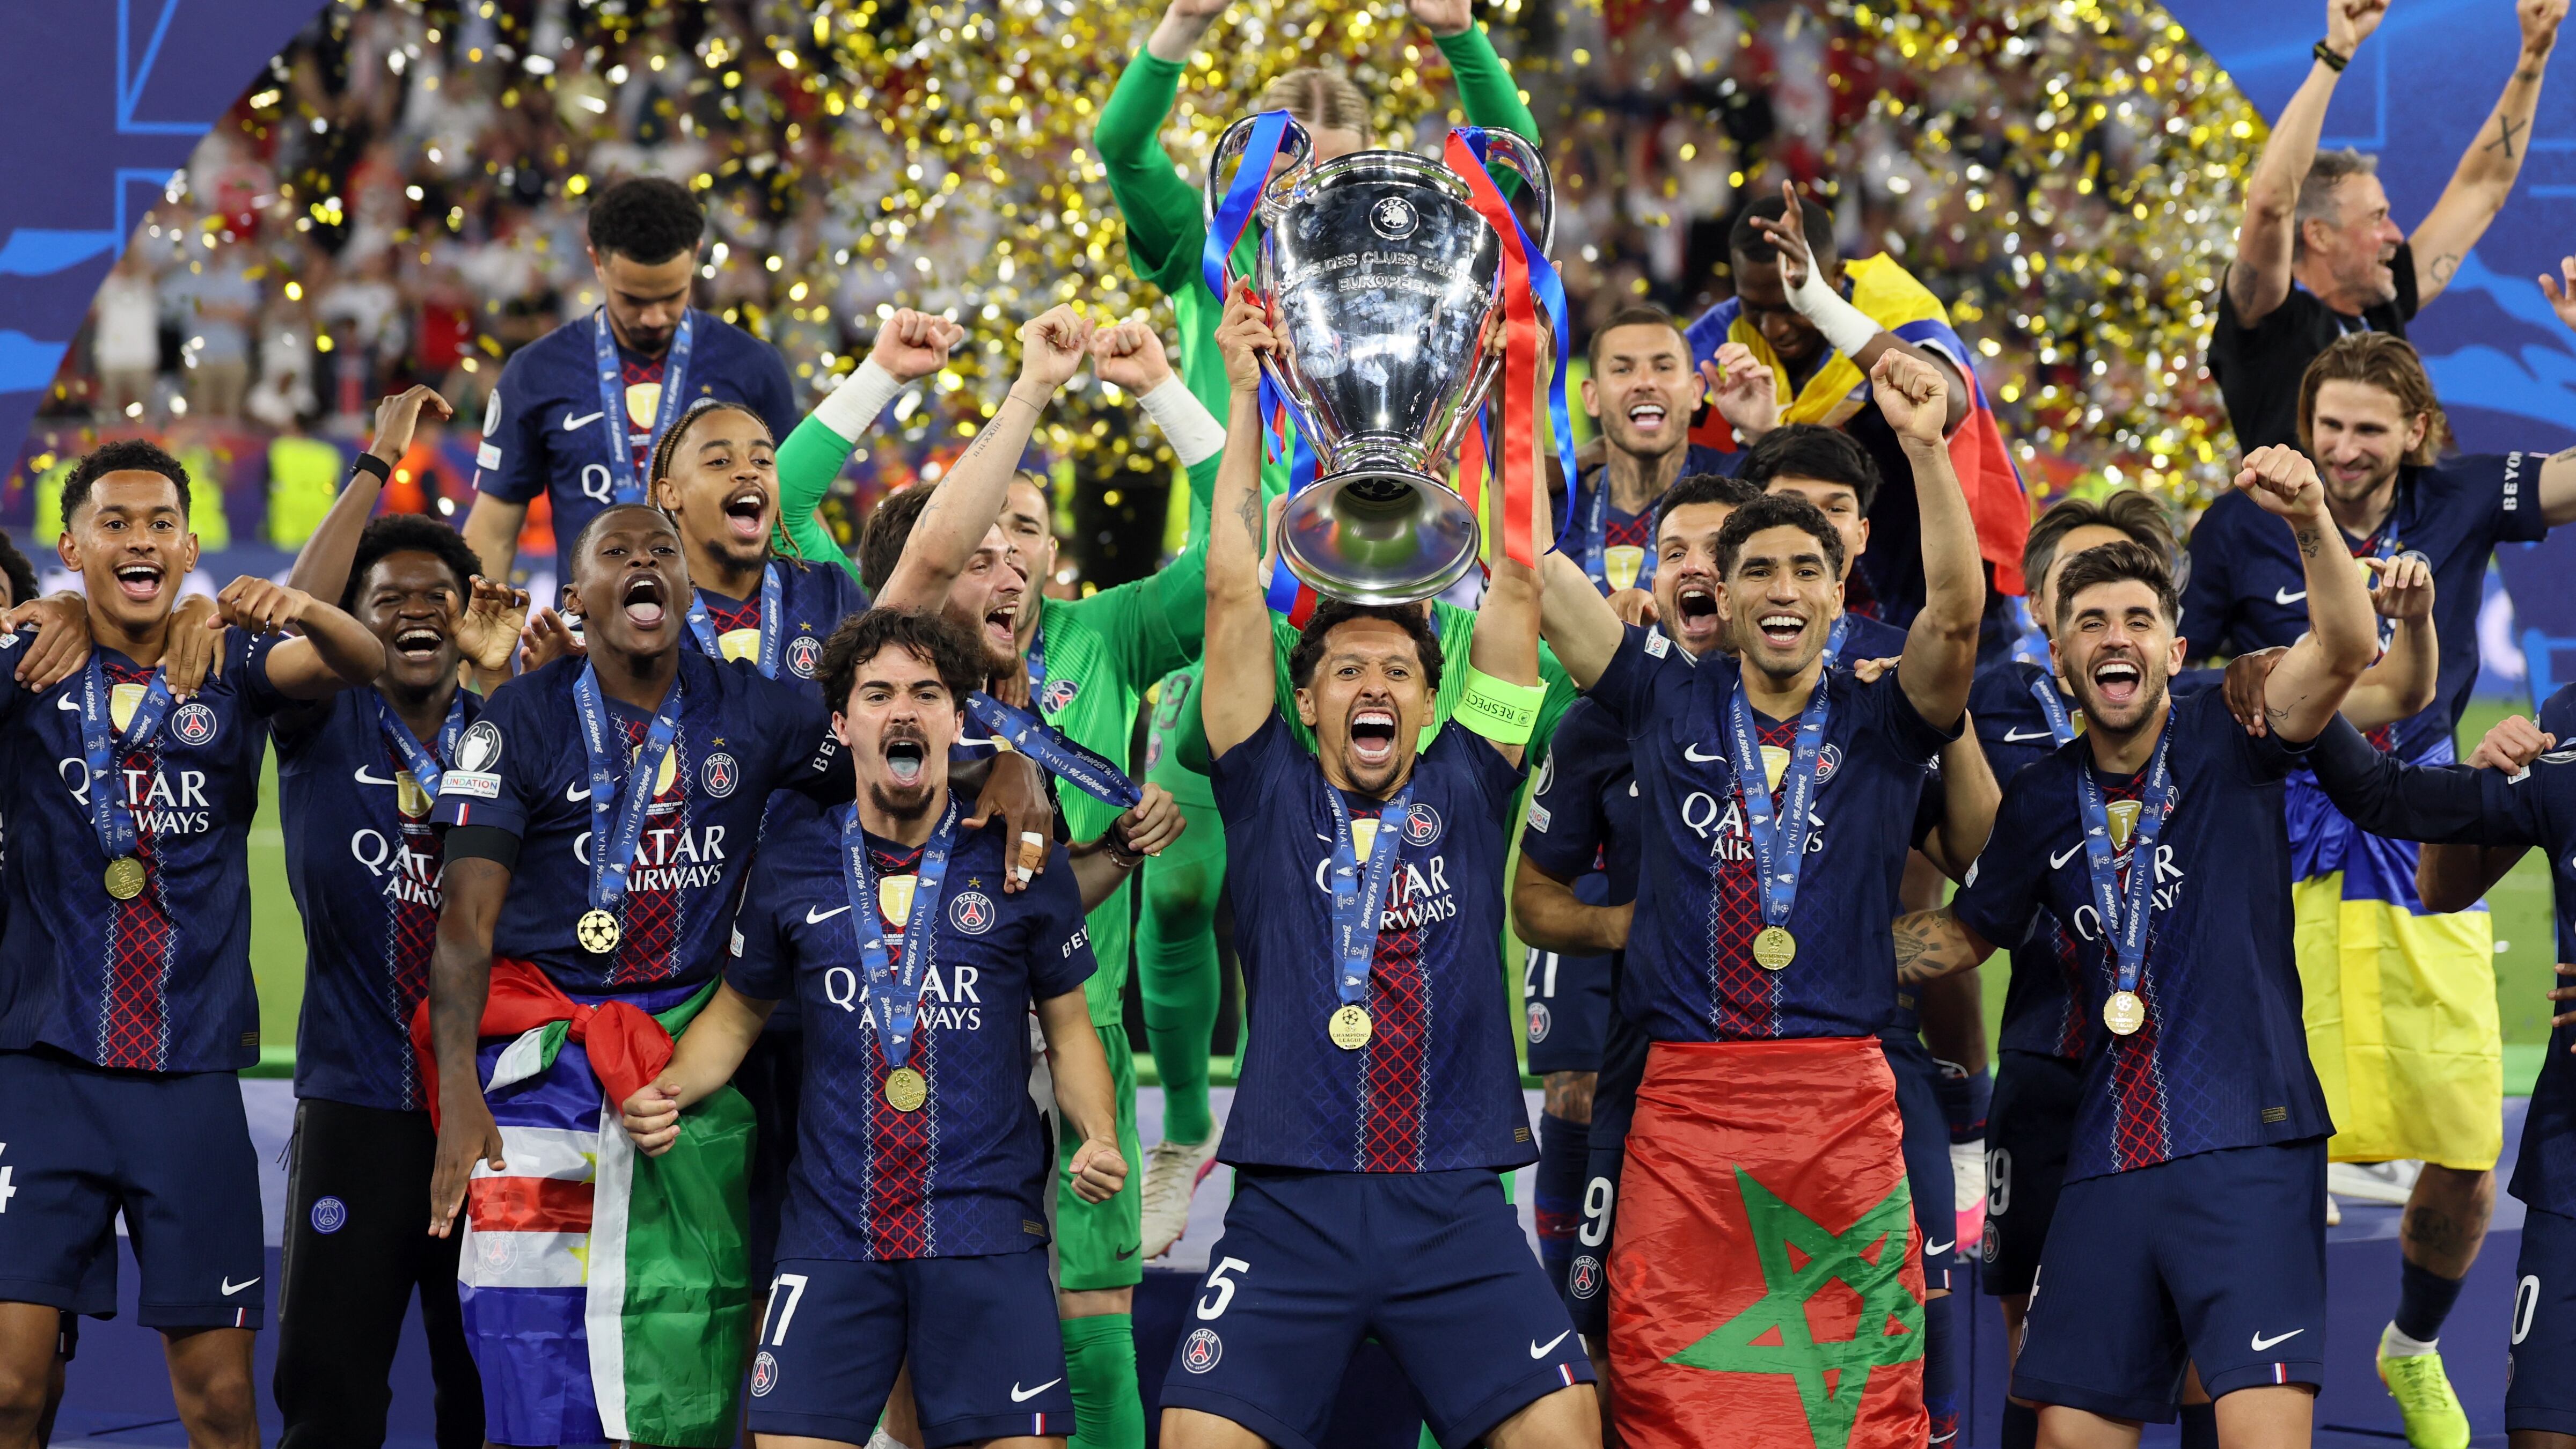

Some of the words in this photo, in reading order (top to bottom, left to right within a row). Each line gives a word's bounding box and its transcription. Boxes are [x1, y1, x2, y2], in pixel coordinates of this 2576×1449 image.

[1324, 252, 1358, 272] DES
[1361, 251, 1418, 267] CLUBS
[793, 639, 818, 650] PARIS
[580, 680, 593, 707] FINAL
[1043, 682, 1065, 703] PARIS
[1465, 692, 1515, 720] RESPECT
[178, 706, 208, 718] PARIS
[1733, 700, 1744, 728] FINAL
[589, 718, 603, 754] BUDAPEST
[706, 755, 732, 767] PARIS
[1040, 747, 1069, 771] FINAL
[1738, 736, 1755, 771] BUDAPEST
[58, 757, 210, 808] QTAR
[636, 765, 653, 802] BUDAPEST
[1076, 772, 1112, 796] BUDAPEST
[1794, 774, 1807, 811] BUDAPEST
[2087, 781, 2098, 810] FINAL
[100, 794, 112, 829] FINAL
[597, 828, 606, 862] FINAL
[621, 813, 639, 846] FINAL
[1336, 818, 1348, 850] FINAL
[1785, 822, 1799, 857] FINAL
[1760, 839, 1772, 874] FINAL
[850, 846, 862, 882] BUDAPEST
[859, 891, 872, 925] FINAL
[1360, 891, 1376, 930] BUDAPEST
[1372, 847, 1388, 880] FINAL
[2133, 862, 2146, 896] FINAL
[957, 894, 988, 906] PARIS
[1379, 894, 1457, 931] RWAYS
[2102, 883, 2119, 920] BUDAPEST
[2133, 898, 2141, 911] 26
[902, 949, 917, 987] BUDAPEST
[911, 903, 926, 937] FINAL
[2127, 909, 2140, 948] BUDAPEST
[824, 964, 981, 1013] QAR
[1984, 1147, 2012, 1216] 19
[1579, 1176, 1614, 1247] 9
[1576, 1257, 1598, 1270] PARIS
[1196, 1256, 1250, 1320] 5
[758, 1273, 809, 1346] 17
[1191, 1330, 1217, 1344] PARIS
[756, 1353, 773, 1366] PARIS
